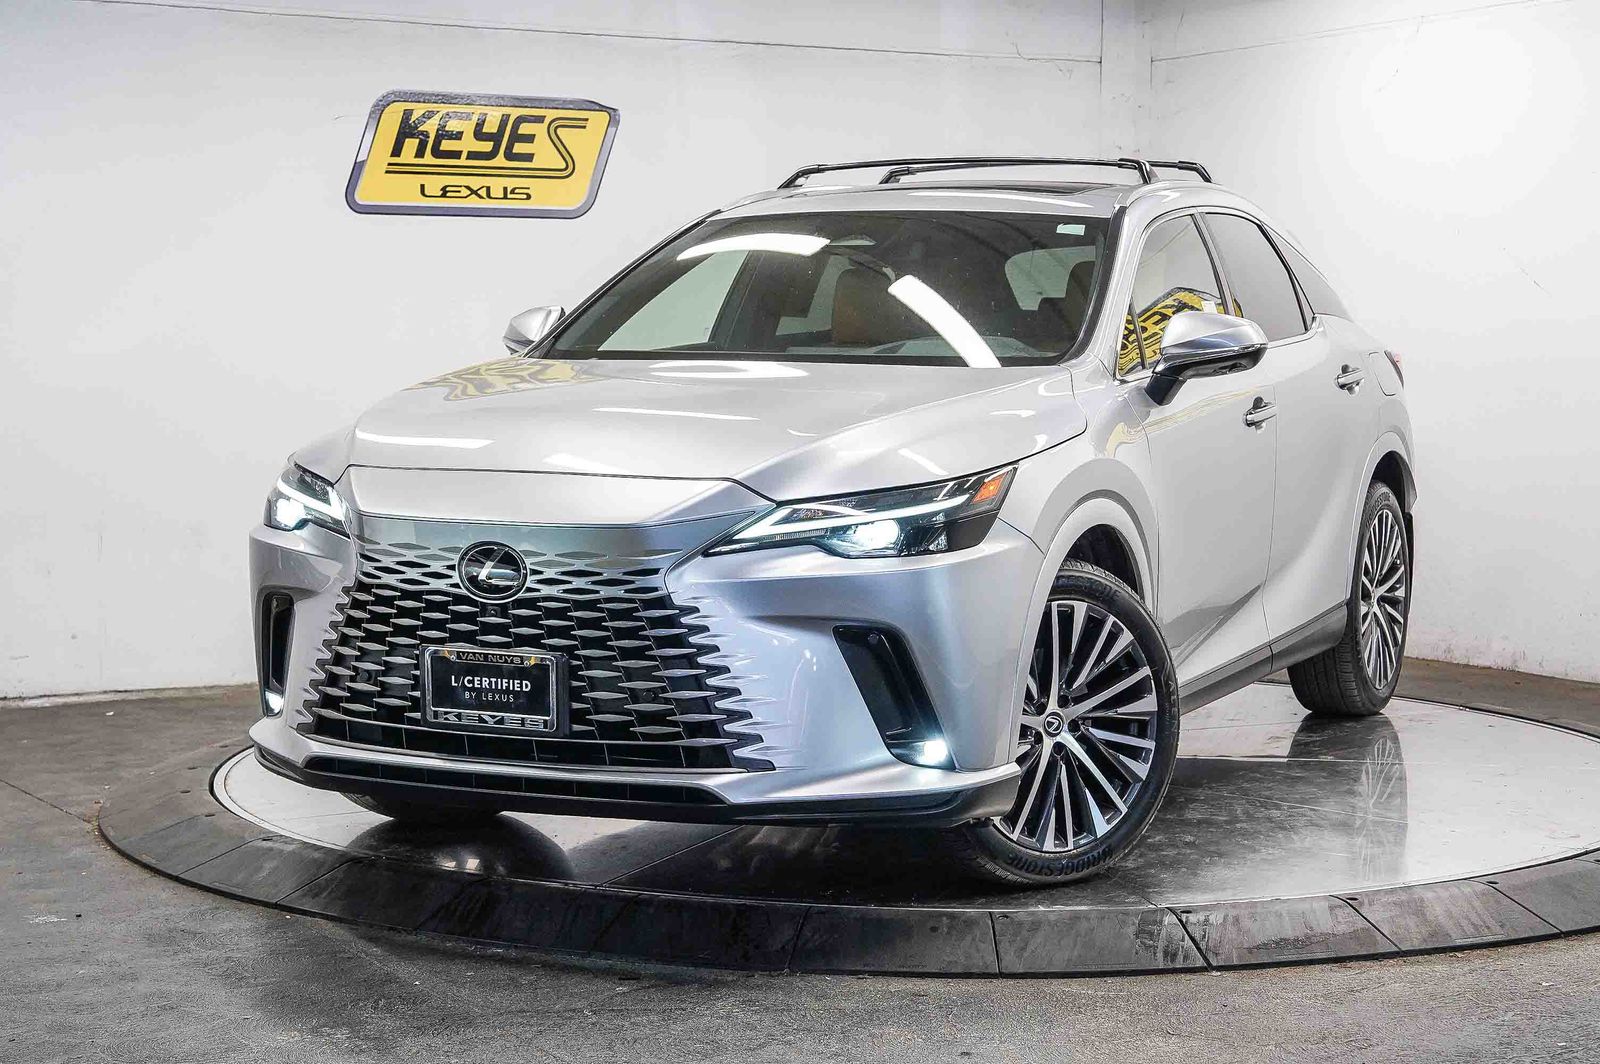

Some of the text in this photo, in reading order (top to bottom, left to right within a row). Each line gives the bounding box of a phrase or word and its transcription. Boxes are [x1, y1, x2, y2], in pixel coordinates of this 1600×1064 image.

[385, 108, 589, 179] KEYES
[419, 183, 532, 201] LEXUS
[459, 652, 521, 664] VAN NUYS
[451, 675, 531, 692] L/CERTIFIED
[464, 691, 514, 702] BY LEXUS
[437, 711, 544, 729] KEYES
